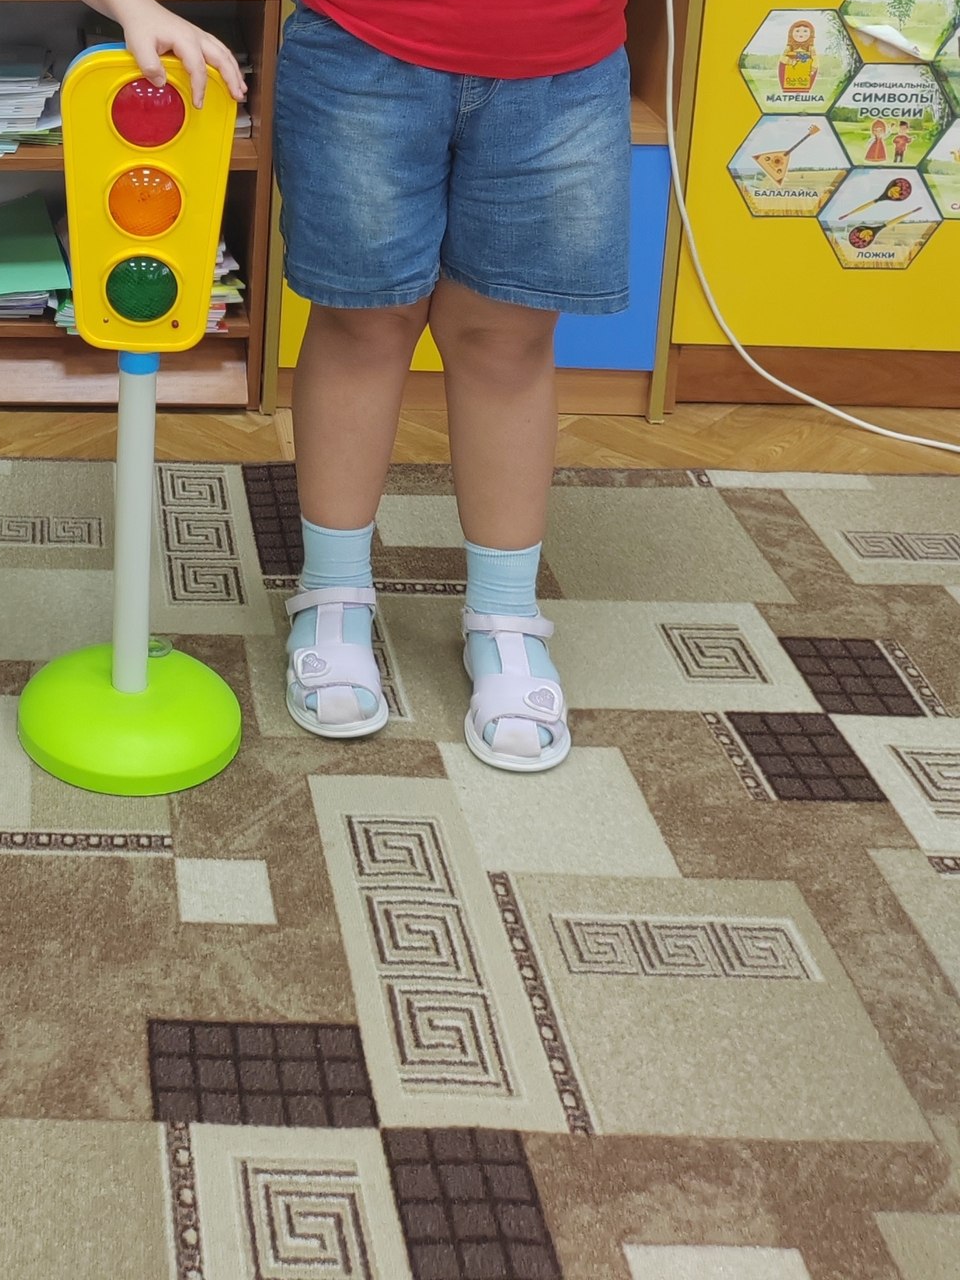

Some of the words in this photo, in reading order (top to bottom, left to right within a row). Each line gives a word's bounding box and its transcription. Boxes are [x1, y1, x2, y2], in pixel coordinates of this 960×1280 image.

[852, 81, 936, 90] НЕОФИЦИАЛЬНЫЕ
[851, 91, 934, 104] СИМВОЛЫ
[859, 107, 924, 118] РОССИИ
[753, 188, 819, 198] БАЛАЛАЙКА
[856, 250, 896, 259] ЛОЖКИ
